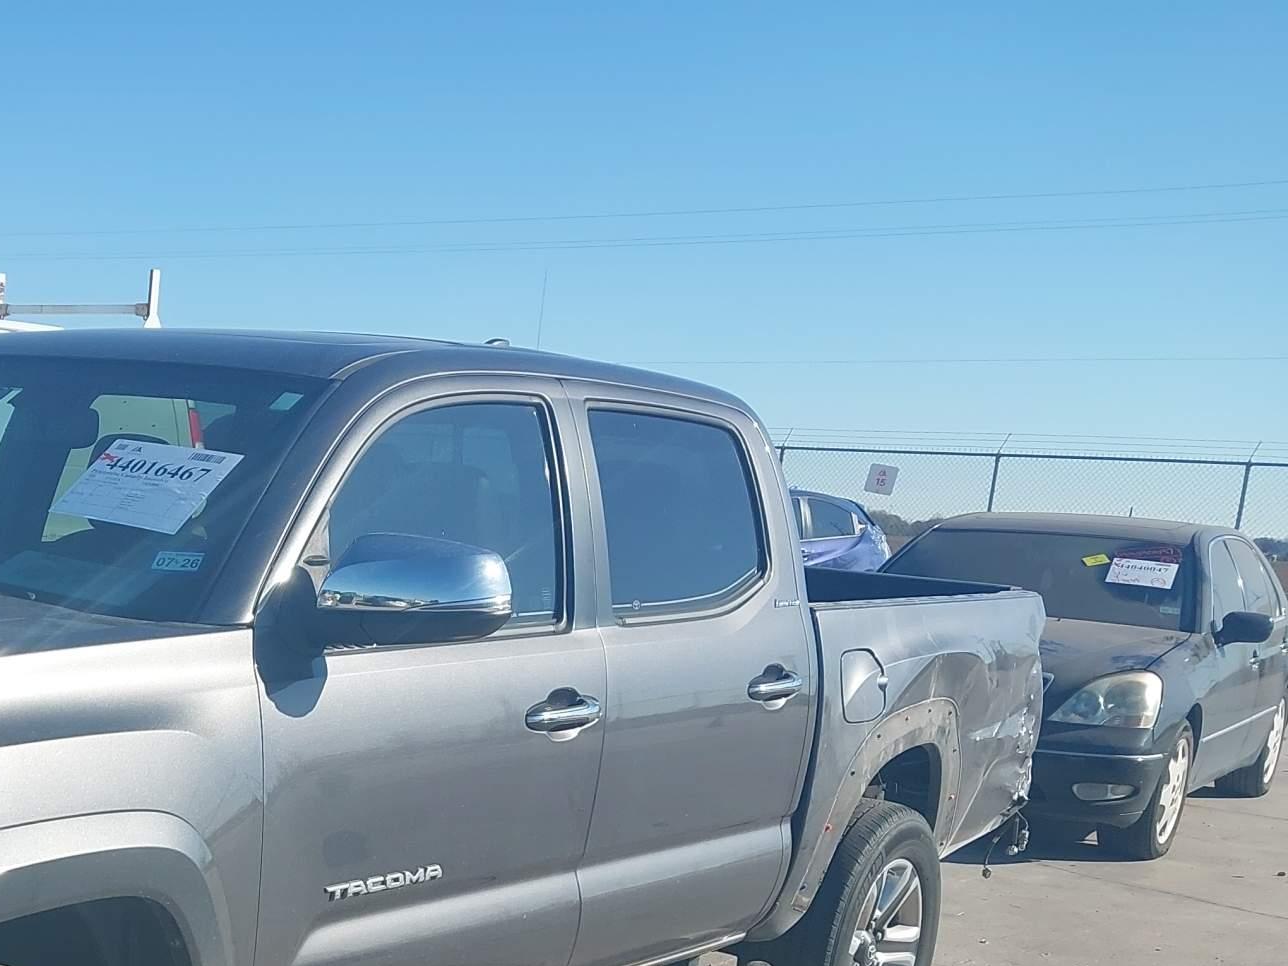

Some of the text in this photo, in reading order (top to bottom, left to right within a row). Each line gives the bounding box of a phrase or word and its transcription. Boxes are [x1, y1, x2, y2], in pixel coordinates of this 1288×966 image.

[106, 456, 213, 482] 44016467
[875, 477, 887, 487] 15
[155, 557, 201, 569] 07 26
[323, 863, 443, 901] TACOMA
